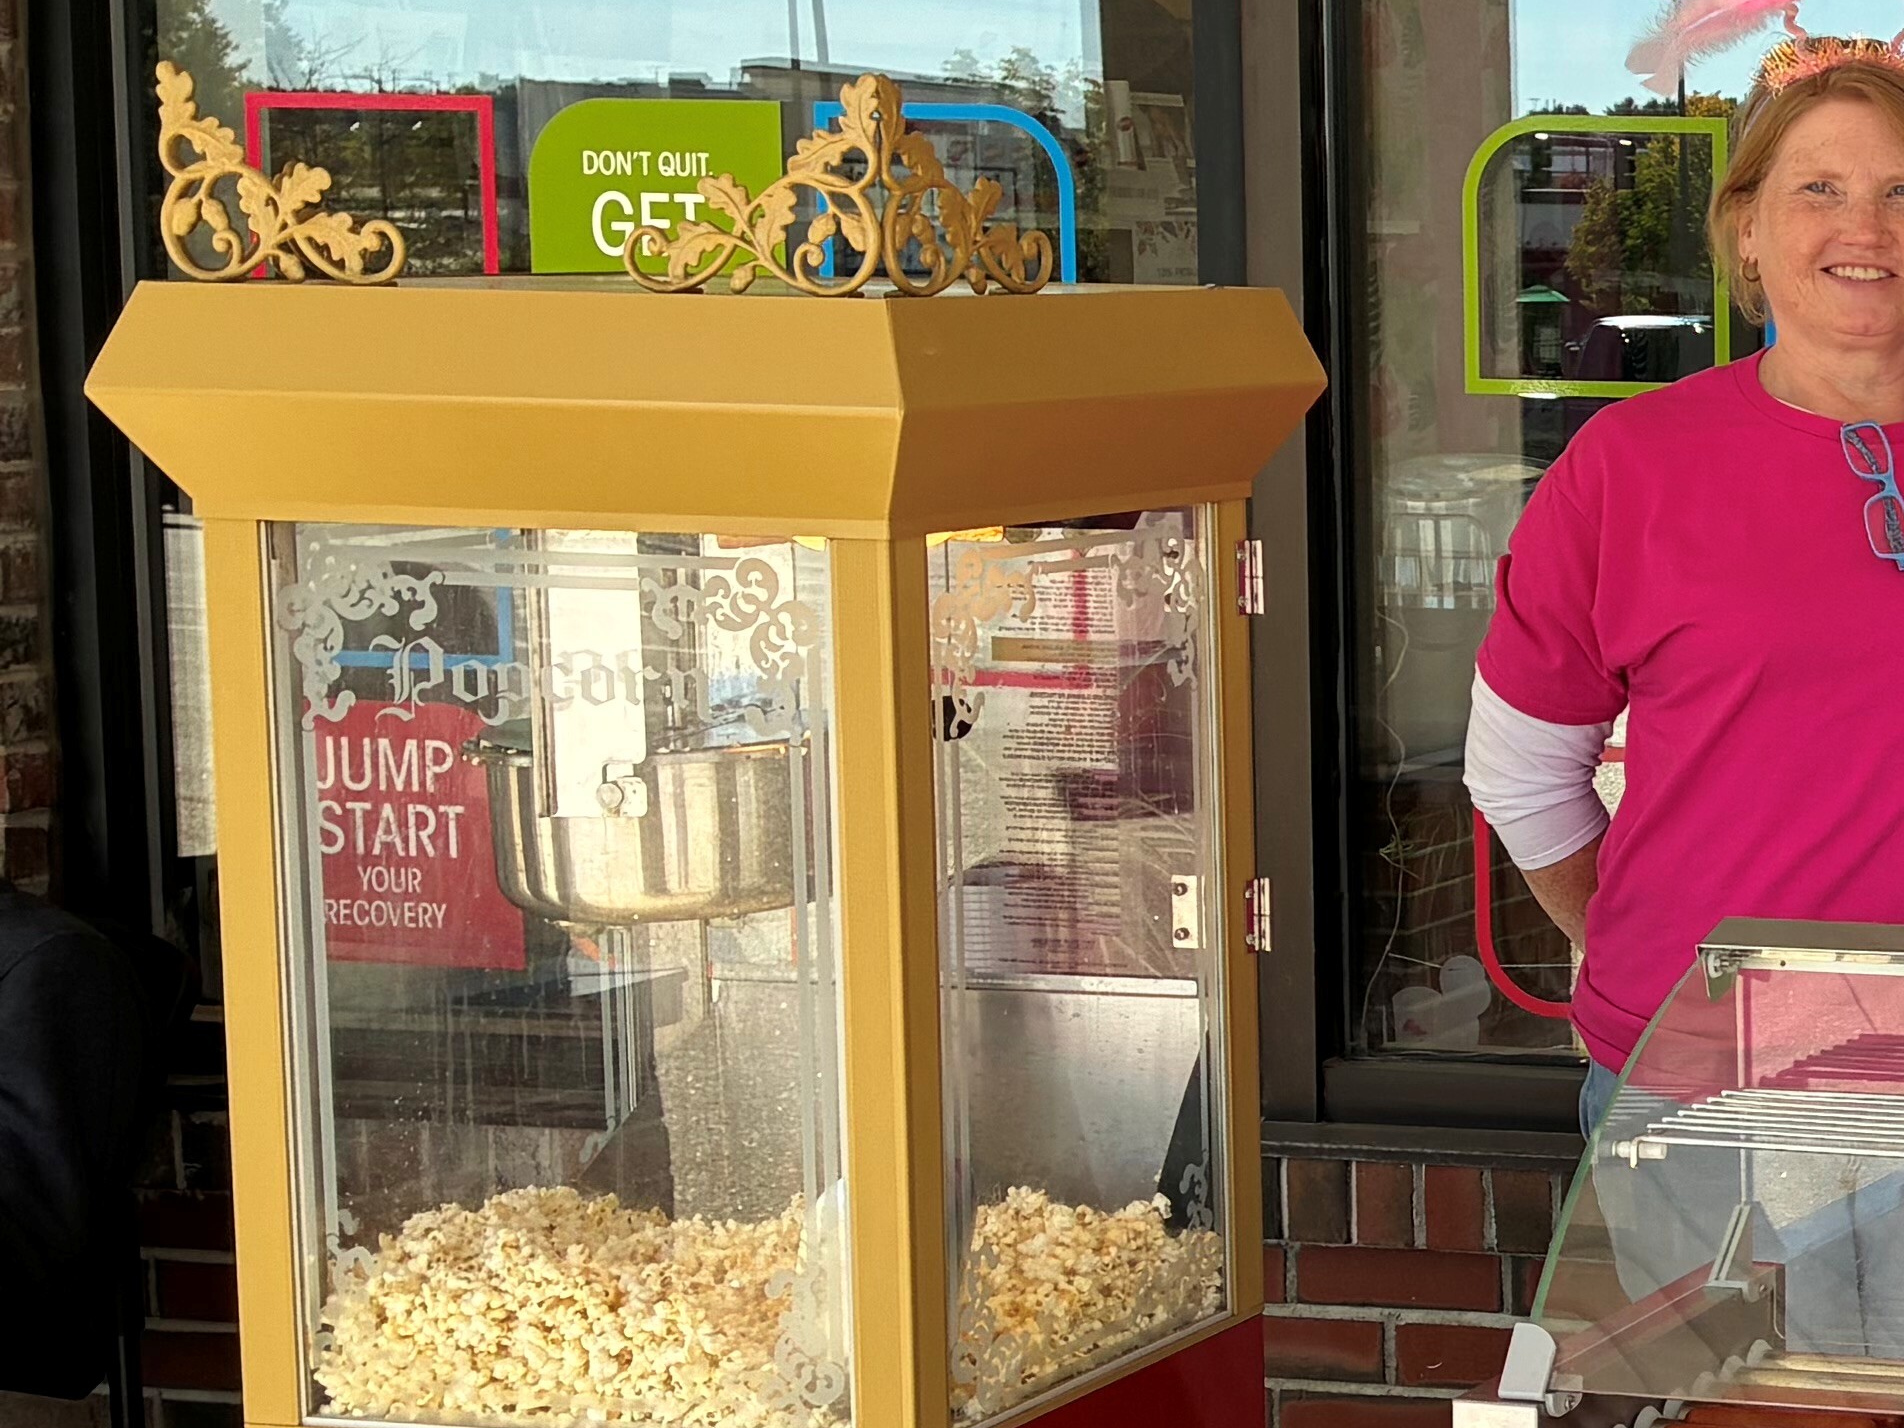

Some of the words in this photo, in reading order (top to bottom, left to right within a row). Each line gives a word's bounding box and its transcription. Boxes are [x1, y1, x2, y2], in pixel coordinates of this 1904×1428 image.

[582, 149, 651, 176] DON'T
[658, 151, 714, 177] QUIT.
[592, 190, 706, 257] GET
[369, 634, 726, 726] Popcorn
[315, 734, 454, 794] JUMP
[318, 800, 465, 861] START
[356, 864, 422, 895] YOUR
[323, 898, 447, 930] RECOVERY
